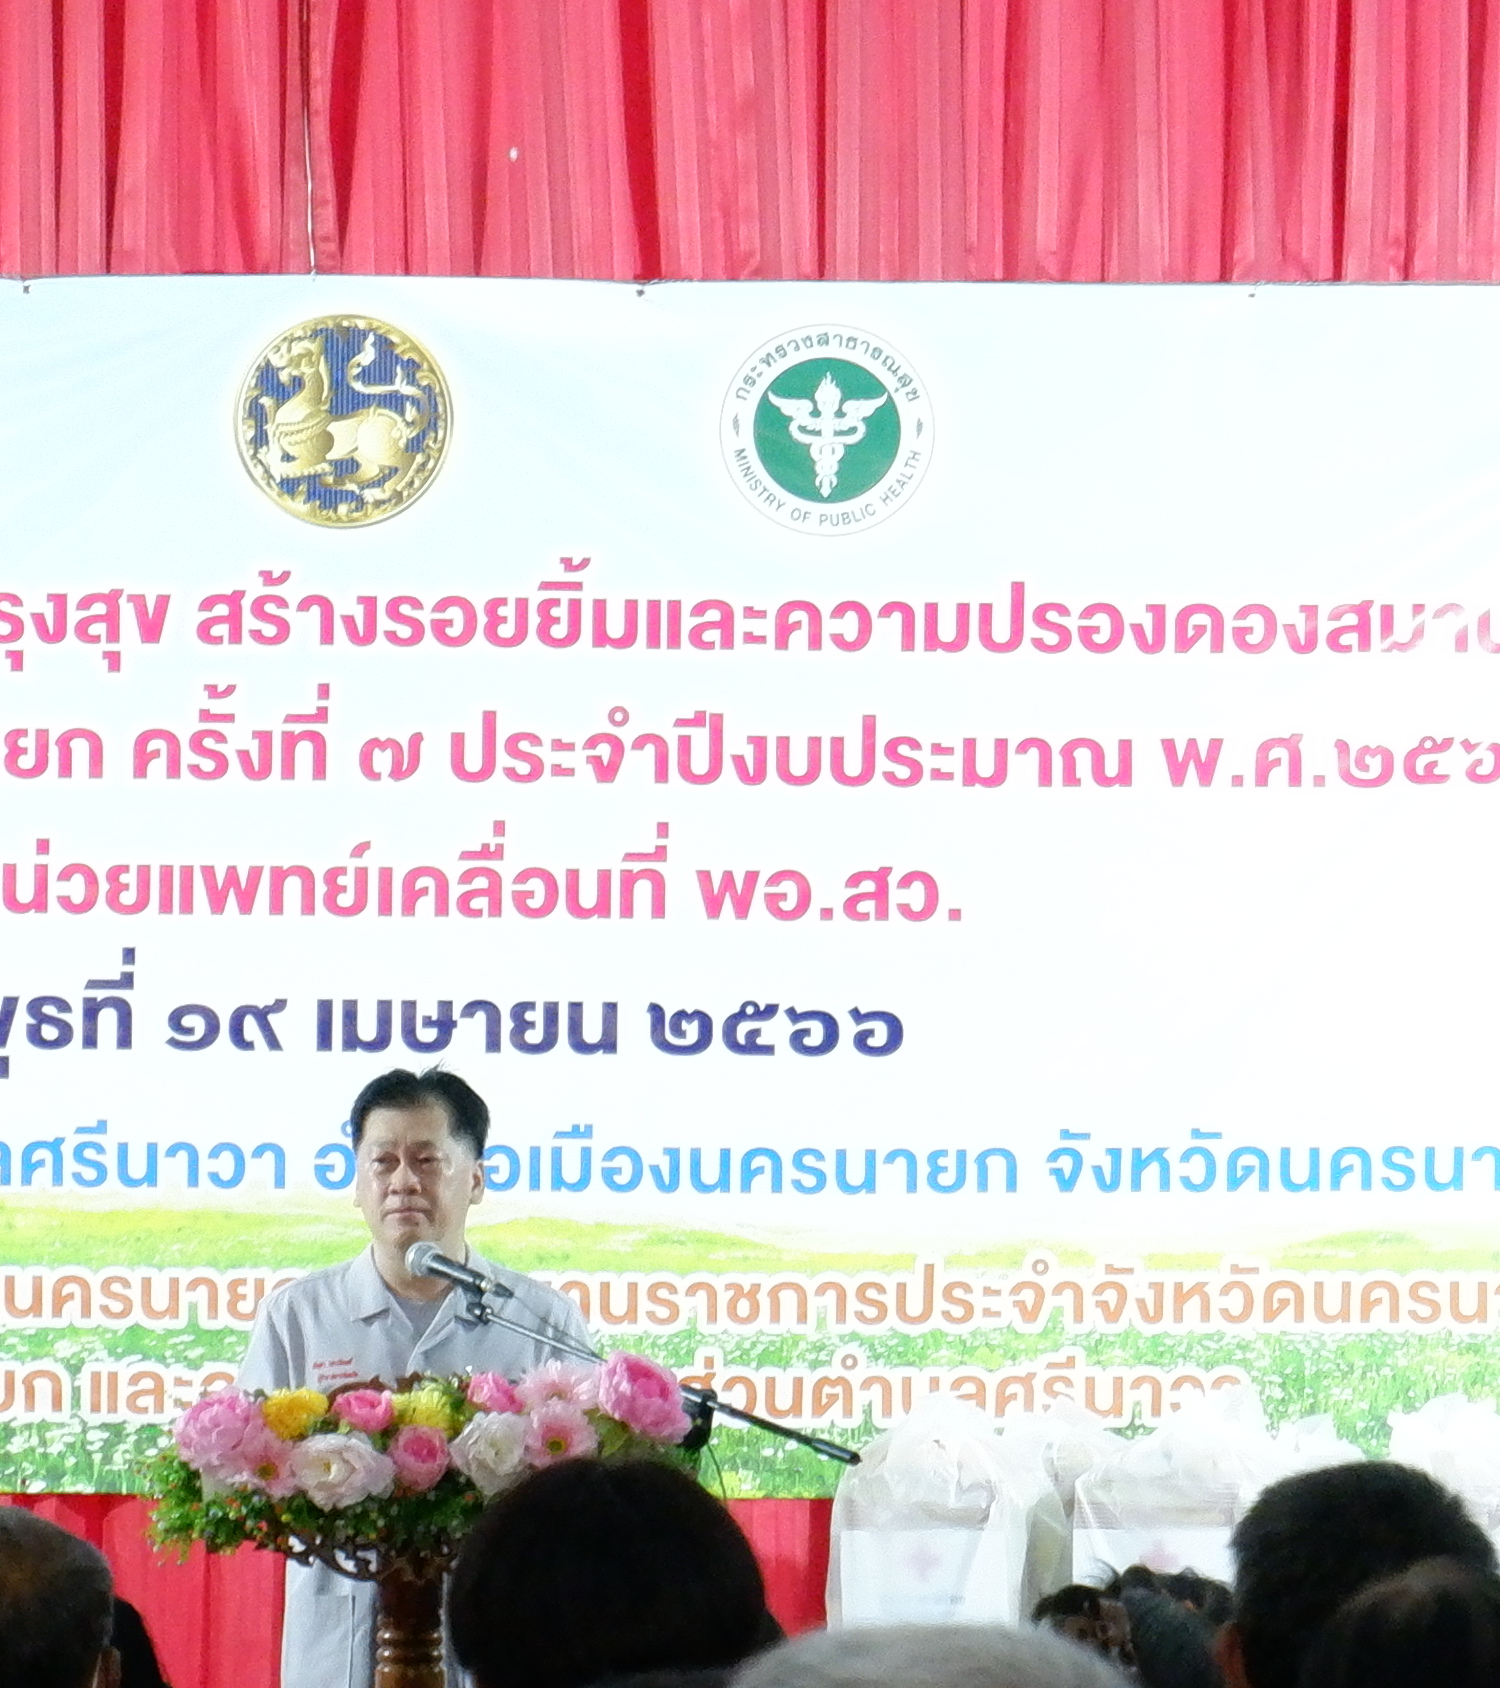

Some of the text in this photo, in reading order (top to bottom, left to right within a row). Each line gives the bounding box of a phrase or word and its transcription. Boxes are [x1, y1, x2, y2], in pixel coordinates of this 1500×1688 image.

[733, 448, 922, 527] MINISTRY OF PUBLIC HEALTH
[132, 683, 331, 781] ครั้งที่
[358, 731, 425, 783] ๗
[450, 705, 1133, 788] ประจำปีงบประมาณ
[696, 866, 963, 922] พอ.สว.
[165, 999, 288, 1052] ๑๙
[316, 998, 619, 1056] เมษายน
[645, 1000, 905, 1058] ๒๕๖๖
